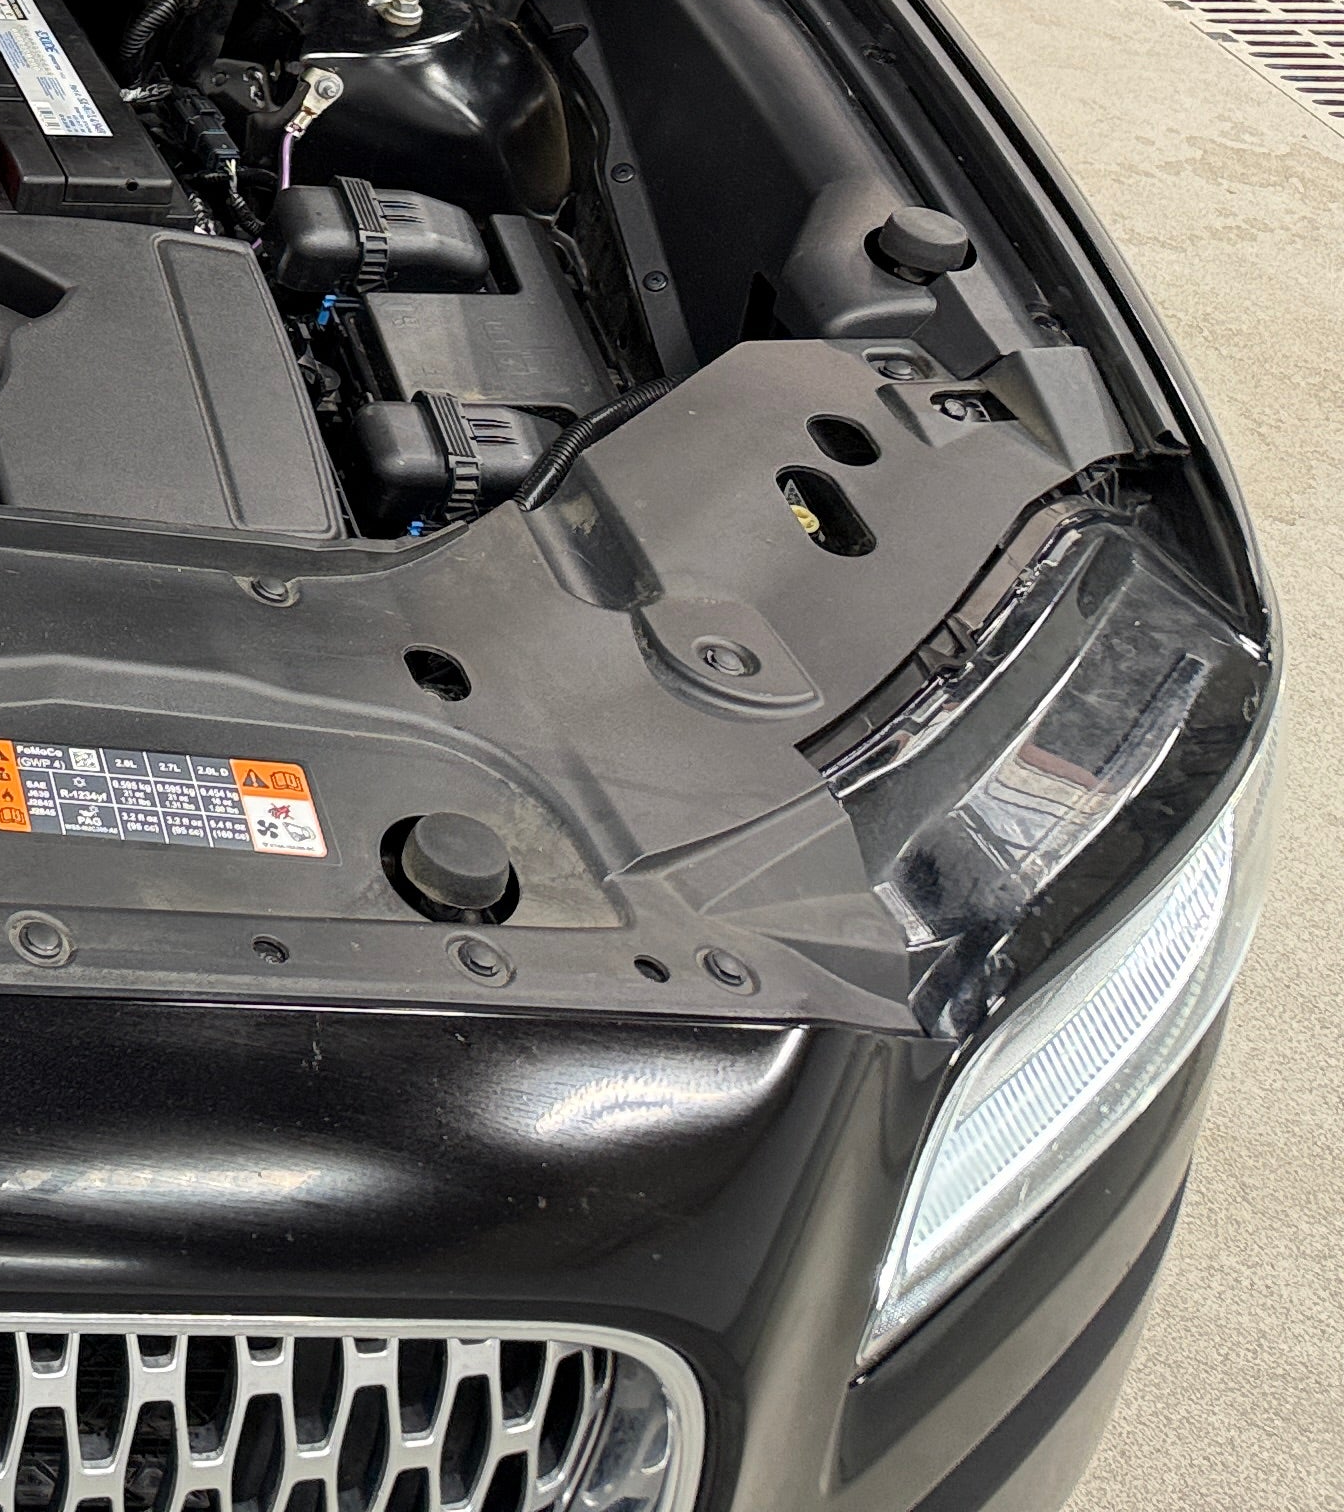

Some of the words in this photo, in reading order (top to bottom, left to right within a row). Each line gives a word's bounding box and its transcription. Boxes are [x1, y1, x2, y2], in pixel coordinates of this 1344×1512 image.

[16, 745, 63, 758] FoMoCo
[16, 757, 51, 769] (GWP
[158, 762, 182, 773] 2.7L
[25, 780, 47, 790] SAE
[138, 782, 152, 794] kg
[59, 788, 108, 803] R-1234yf
[182, 786, 196, 798] kg
[226, 789, 240, 802] kg
[76, 816, 103, 826] PAG
[146, 815, 159, 824] oz
[190, 819, 204, 828] oz
[233, 822, 247, 832] oz
